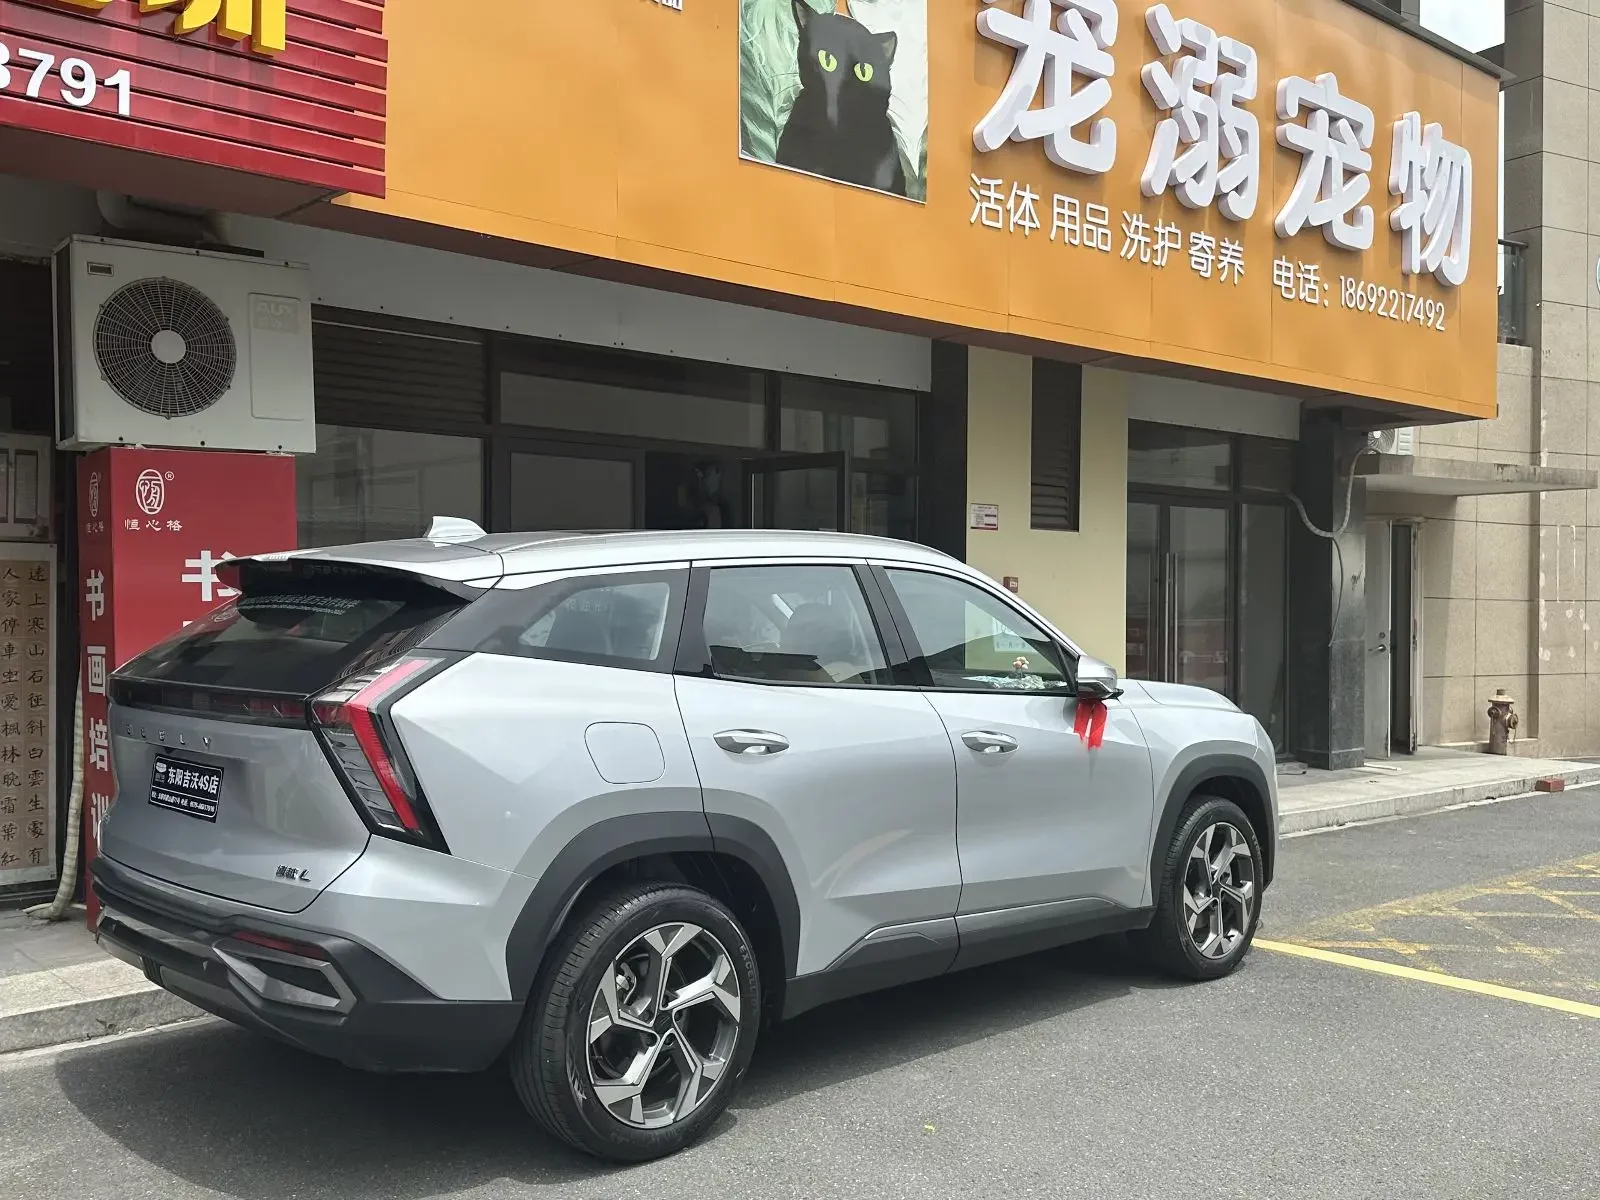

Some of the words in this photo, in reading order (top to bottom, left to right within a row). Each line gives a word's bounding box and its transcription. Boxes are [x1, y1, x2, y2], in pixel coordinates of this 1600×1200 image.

[972, 0, 1472, 286] 宠溺宠物
[969, 173, 1040, 236] 活体
[1050, 193, 1112, 251] 用品
[1120, 210, 1182, 267] 洗护
[1188, 231, 1245, 285] 寄养
[1273, 255, 1329, 307] 电话：
[1339, 275, 1446, 331] 18692217492
[124, 518, 183, 531] 恒心格
[167, 766, 220, 795] 东阳吉沃4S店
